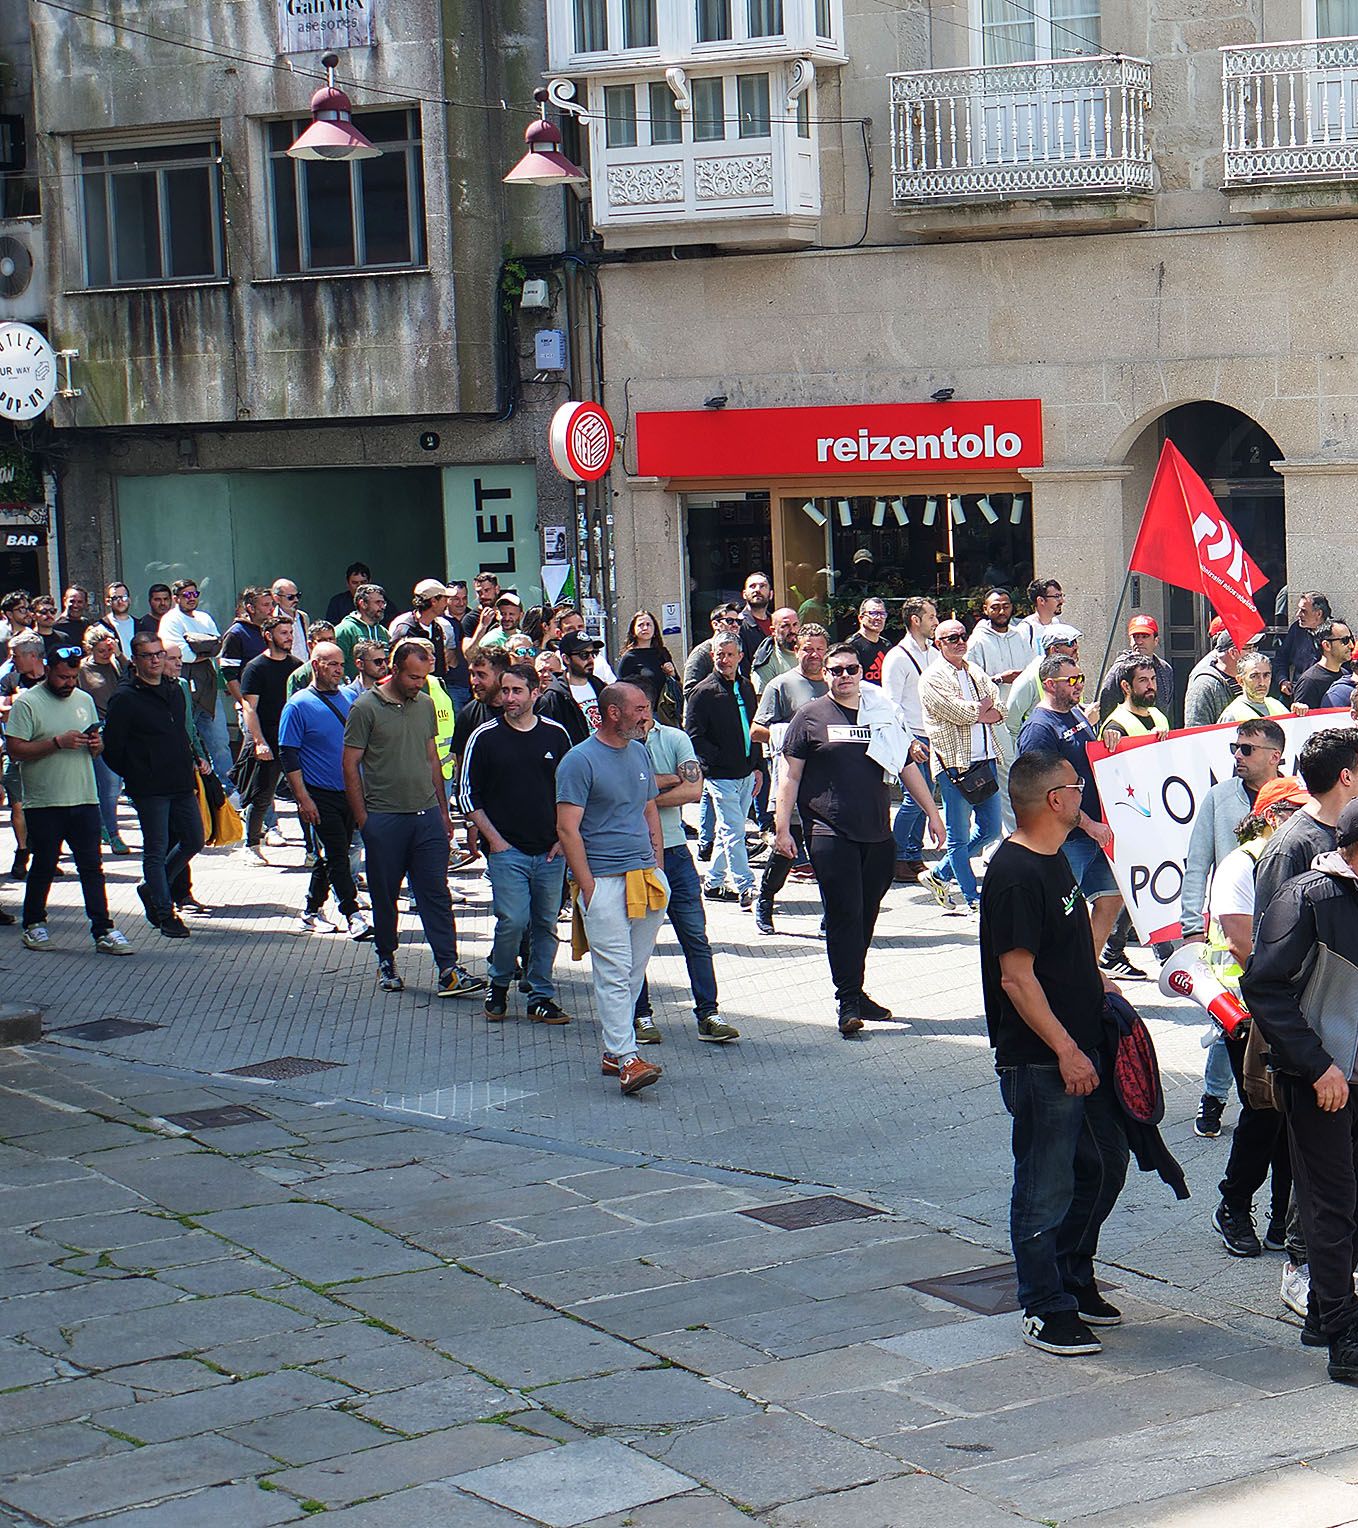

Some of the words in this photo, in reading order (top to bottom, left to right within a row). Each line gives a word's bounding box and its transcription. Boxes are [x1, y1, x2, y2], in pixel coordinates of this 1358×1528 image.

[298, 17, 357, 32] asesores
[16, 366, 31, 374] WAY
[817, 425, 1023, 462] reizentolo
[6, 535, 39, 546] BAR
[1161, 775, 1196, 825] O
[1130, 857, 1189, 910] PO
